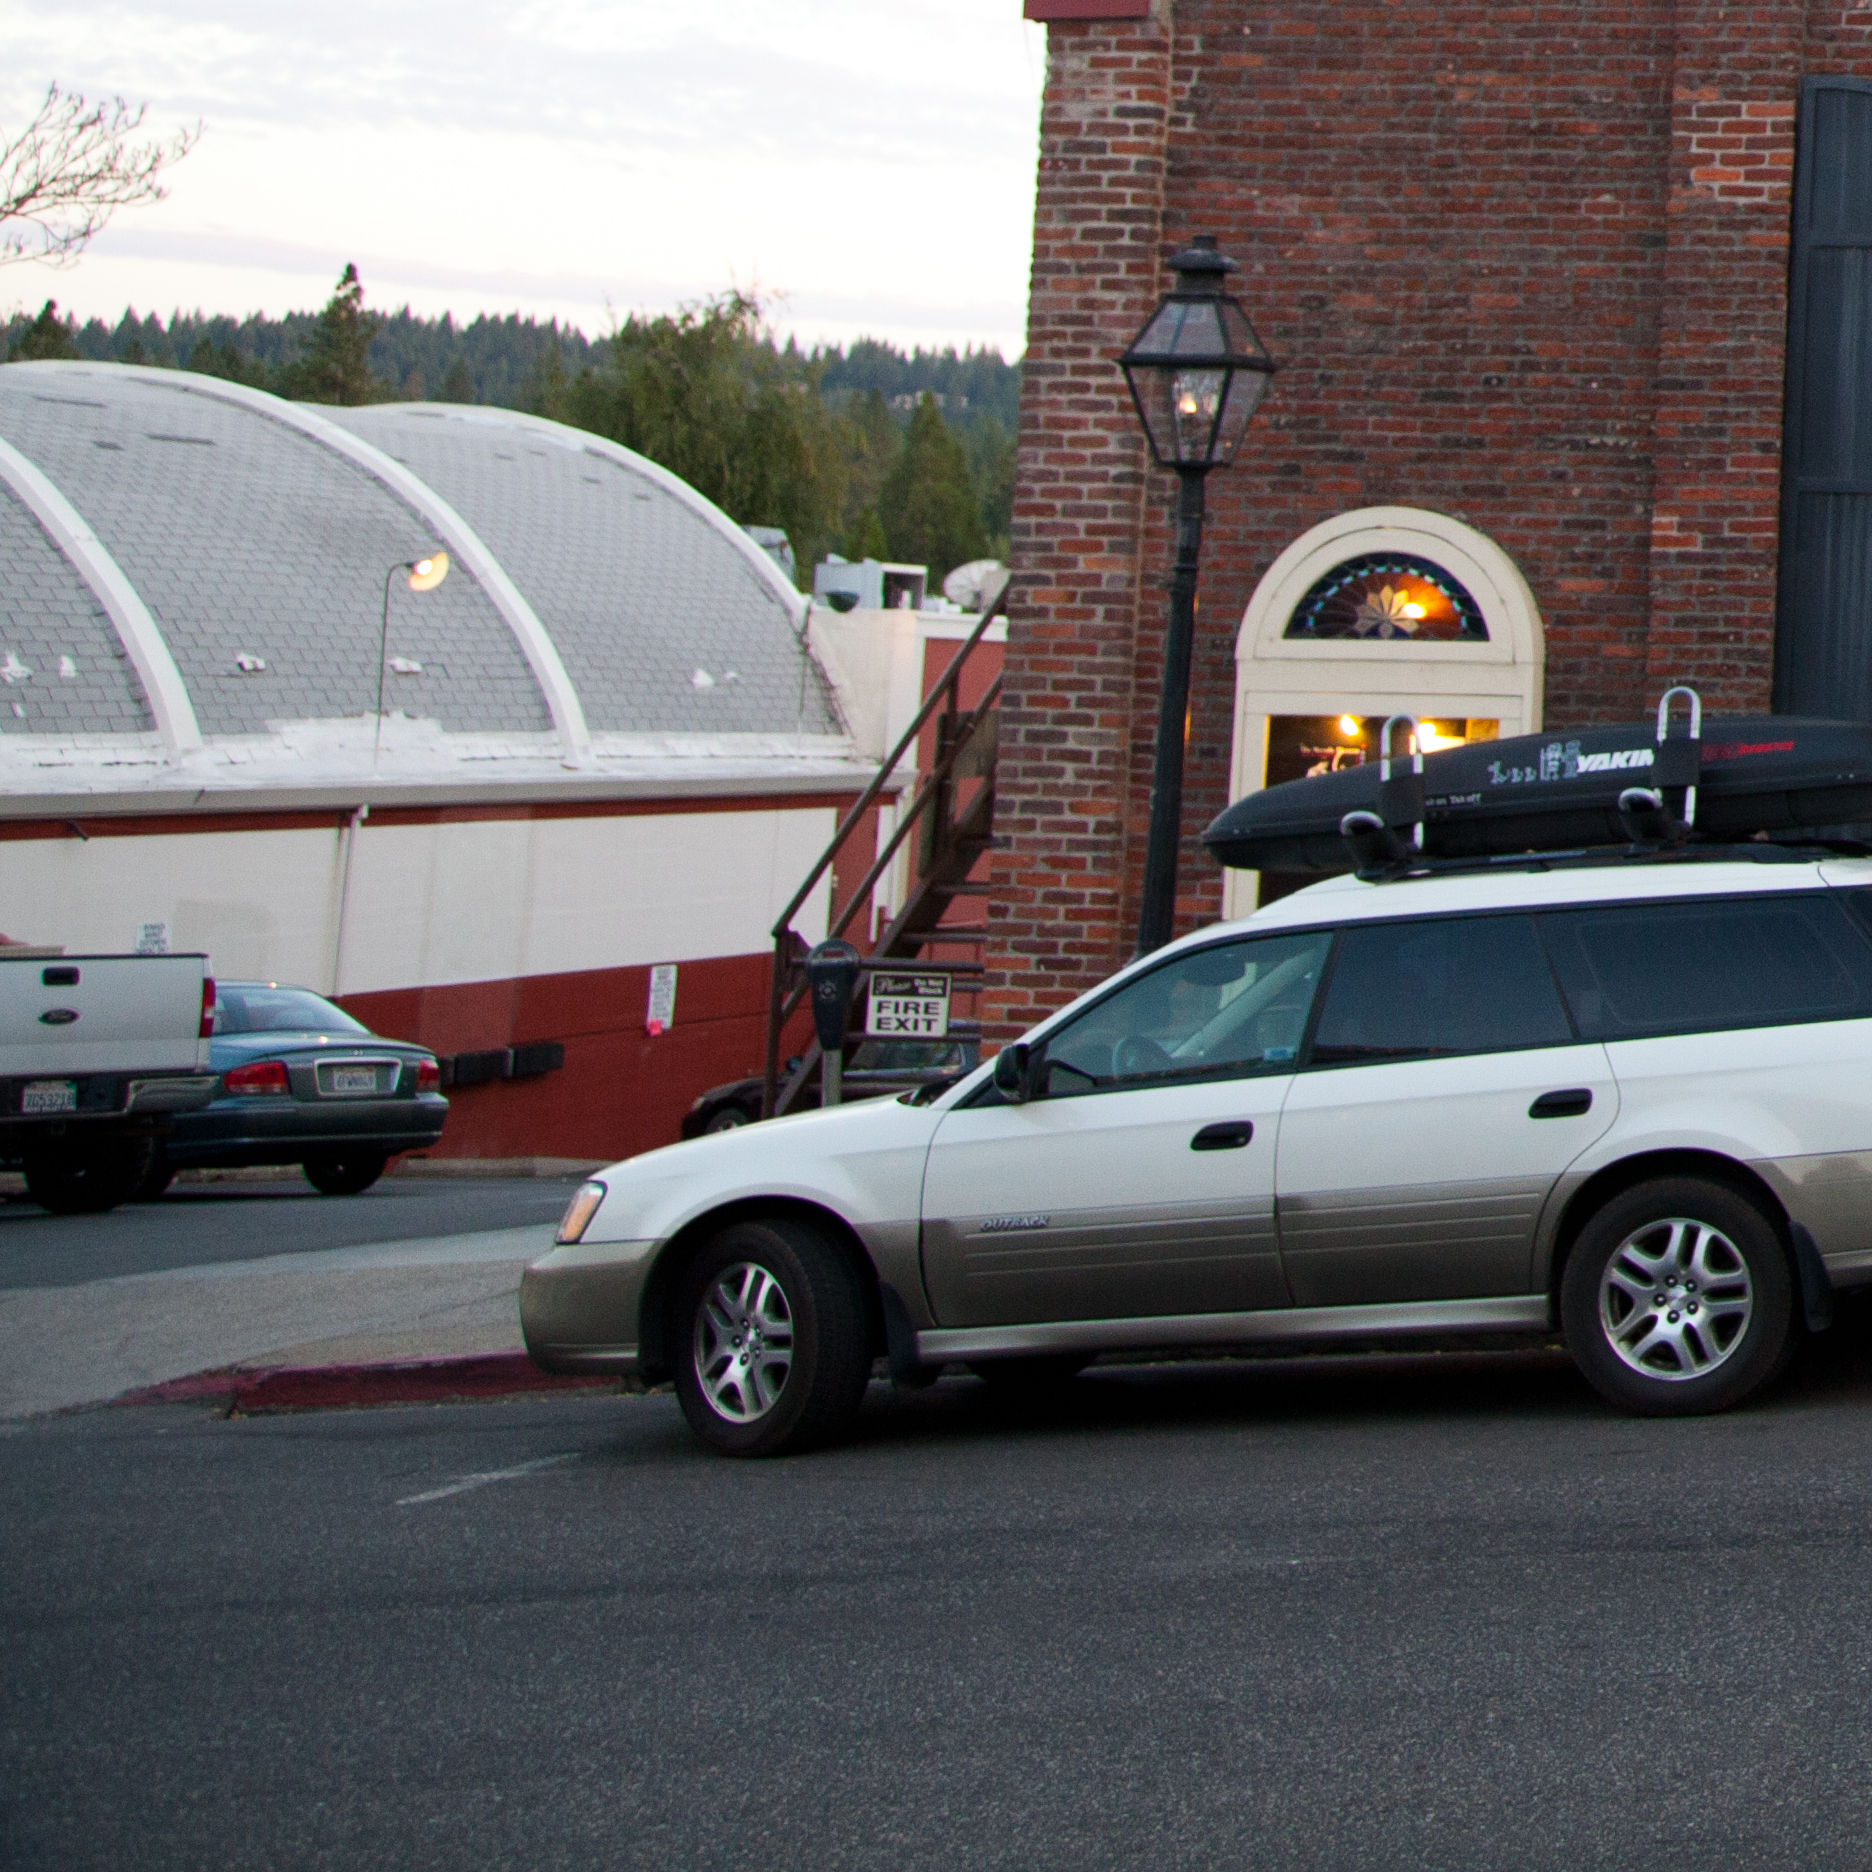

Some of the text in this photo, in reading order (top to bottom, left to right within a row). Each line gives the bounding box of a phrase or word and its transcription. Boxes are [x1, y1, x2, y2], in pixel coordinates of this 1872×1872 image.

[877, 1000, 940, 1015] FIRE
[877, 1017, 938, 1032] EXIT
[980, 1215, 1050, 1232] OUTBACK
